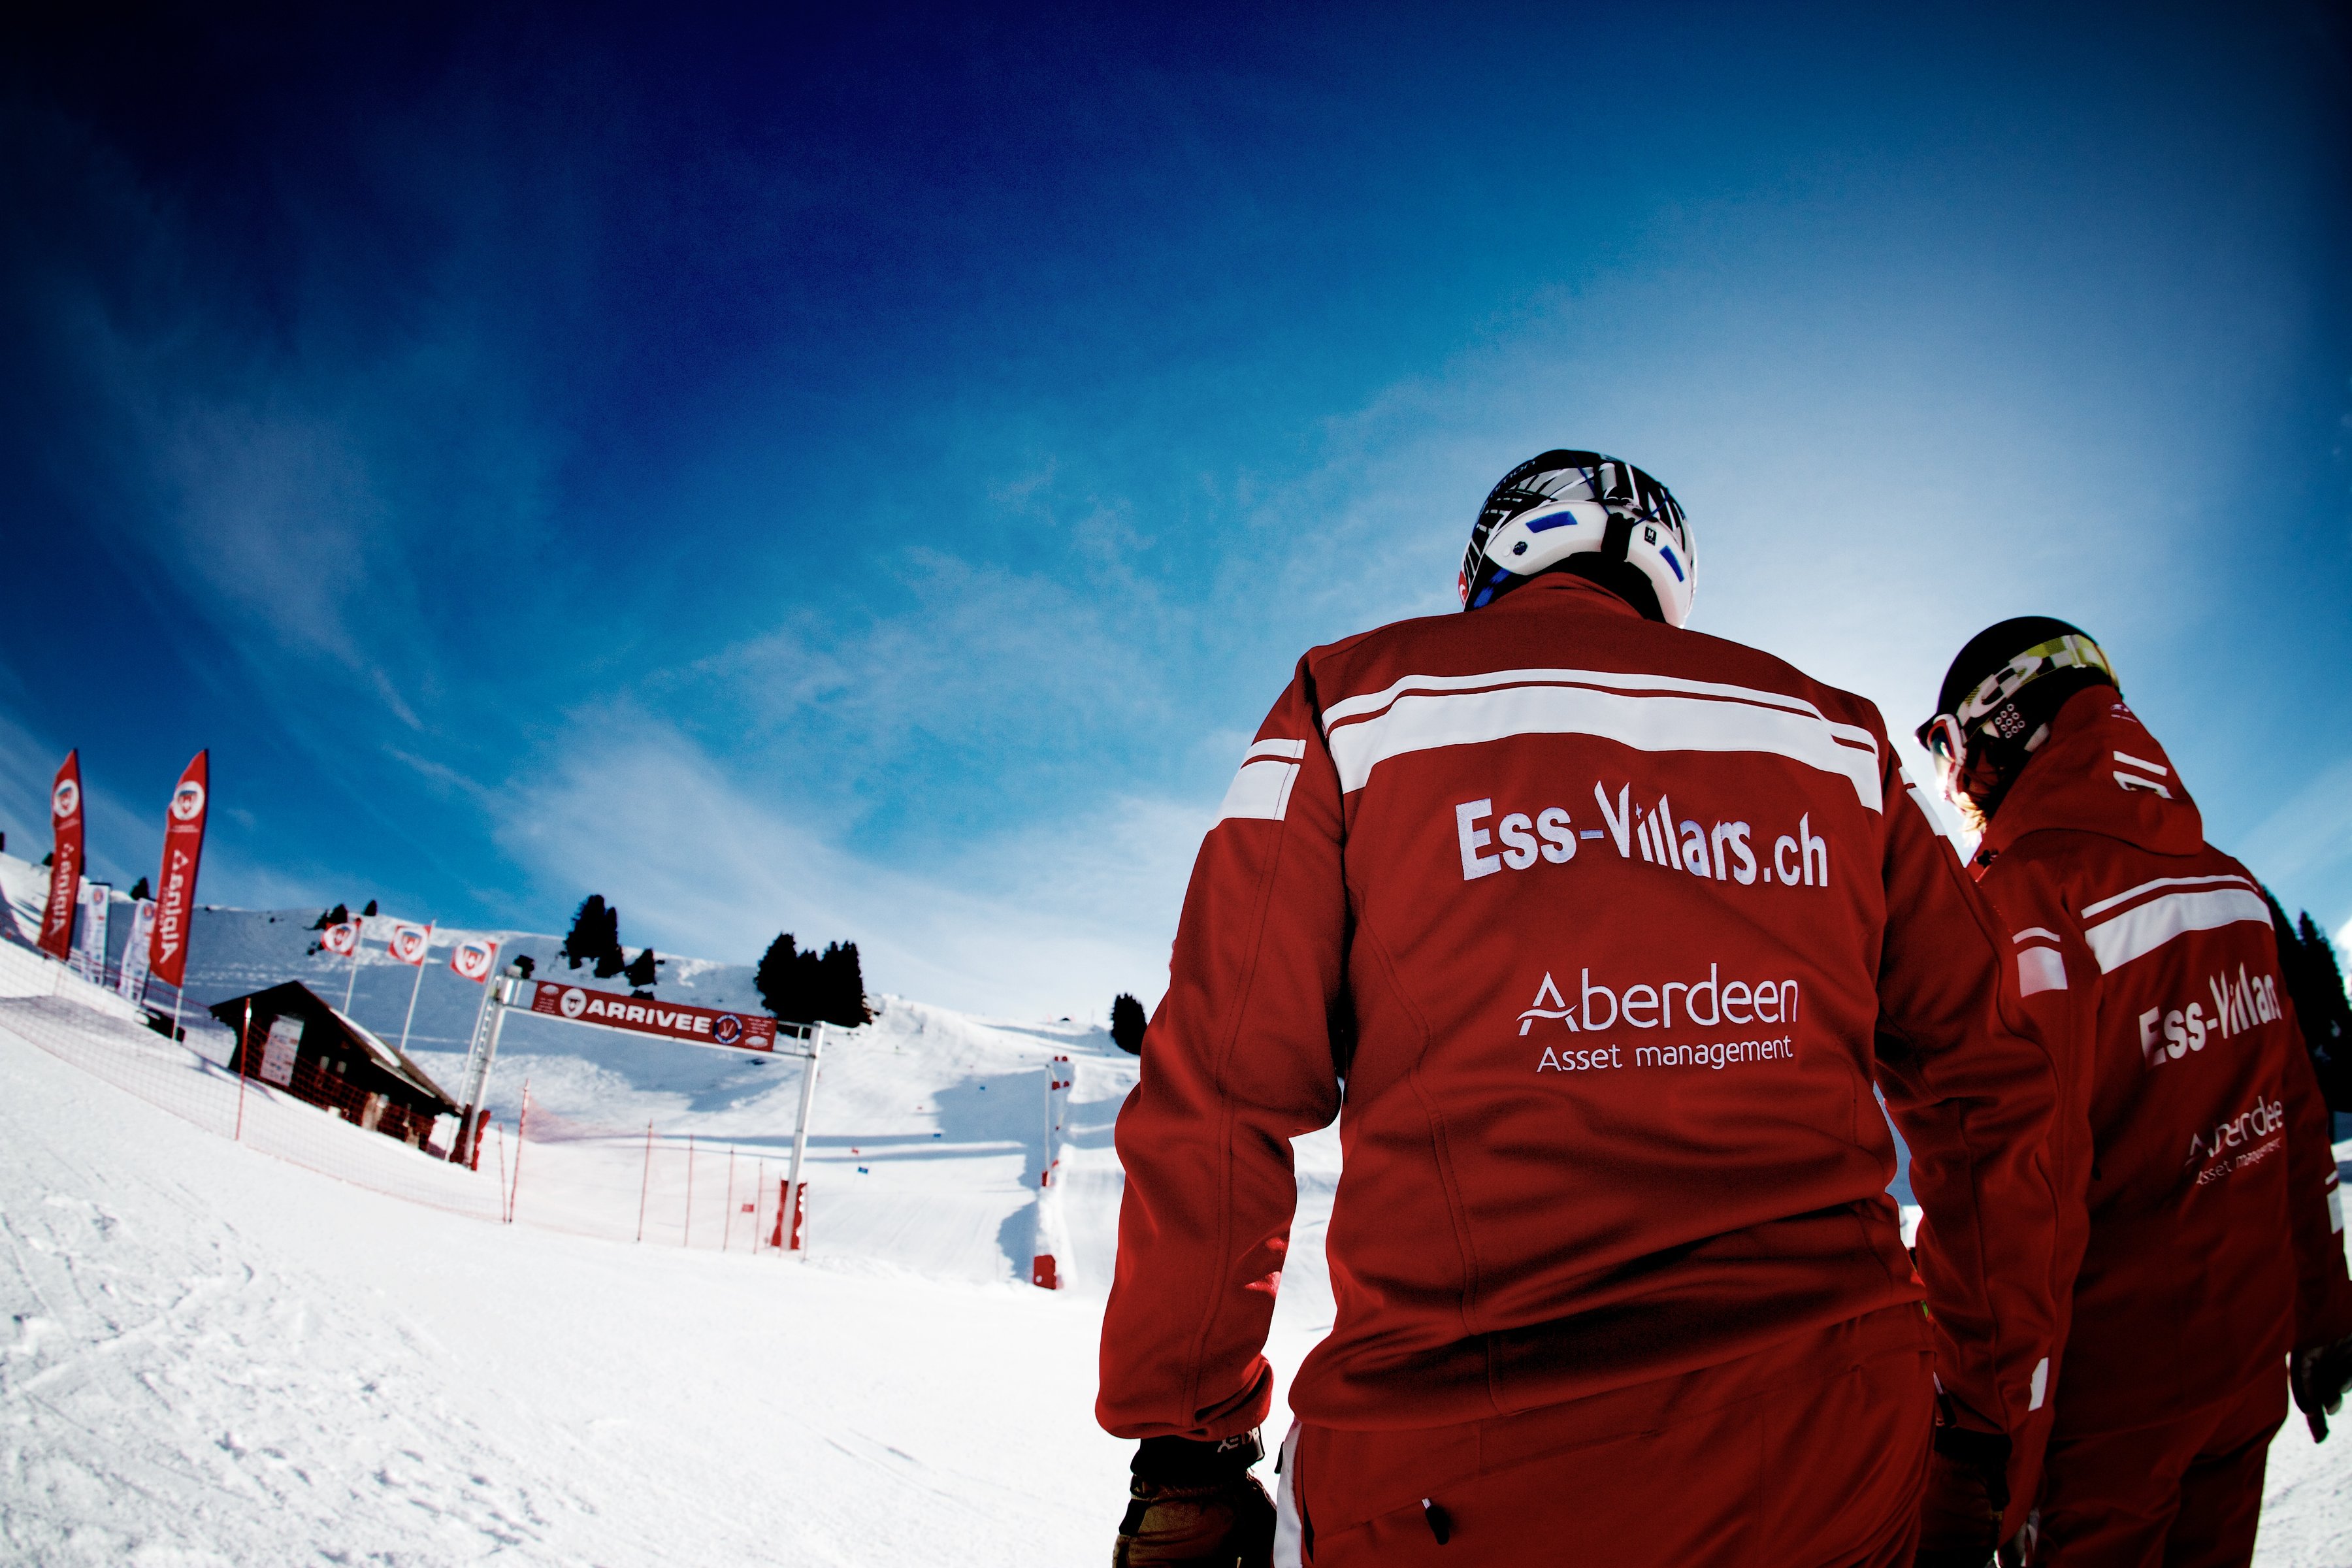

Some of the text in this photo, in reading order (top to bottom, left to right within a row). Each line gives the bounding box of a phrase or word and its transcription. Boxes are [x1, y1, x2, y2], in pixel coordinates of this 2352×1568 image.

[1456, 780, 1828, 887] Ess-Villars.ch
[586, 998, 710, 1034] ARRIVEE
[1516, 963, 1798, 1036] Aberdeen
[1537, 1036, 1793, 1072] Asset management
